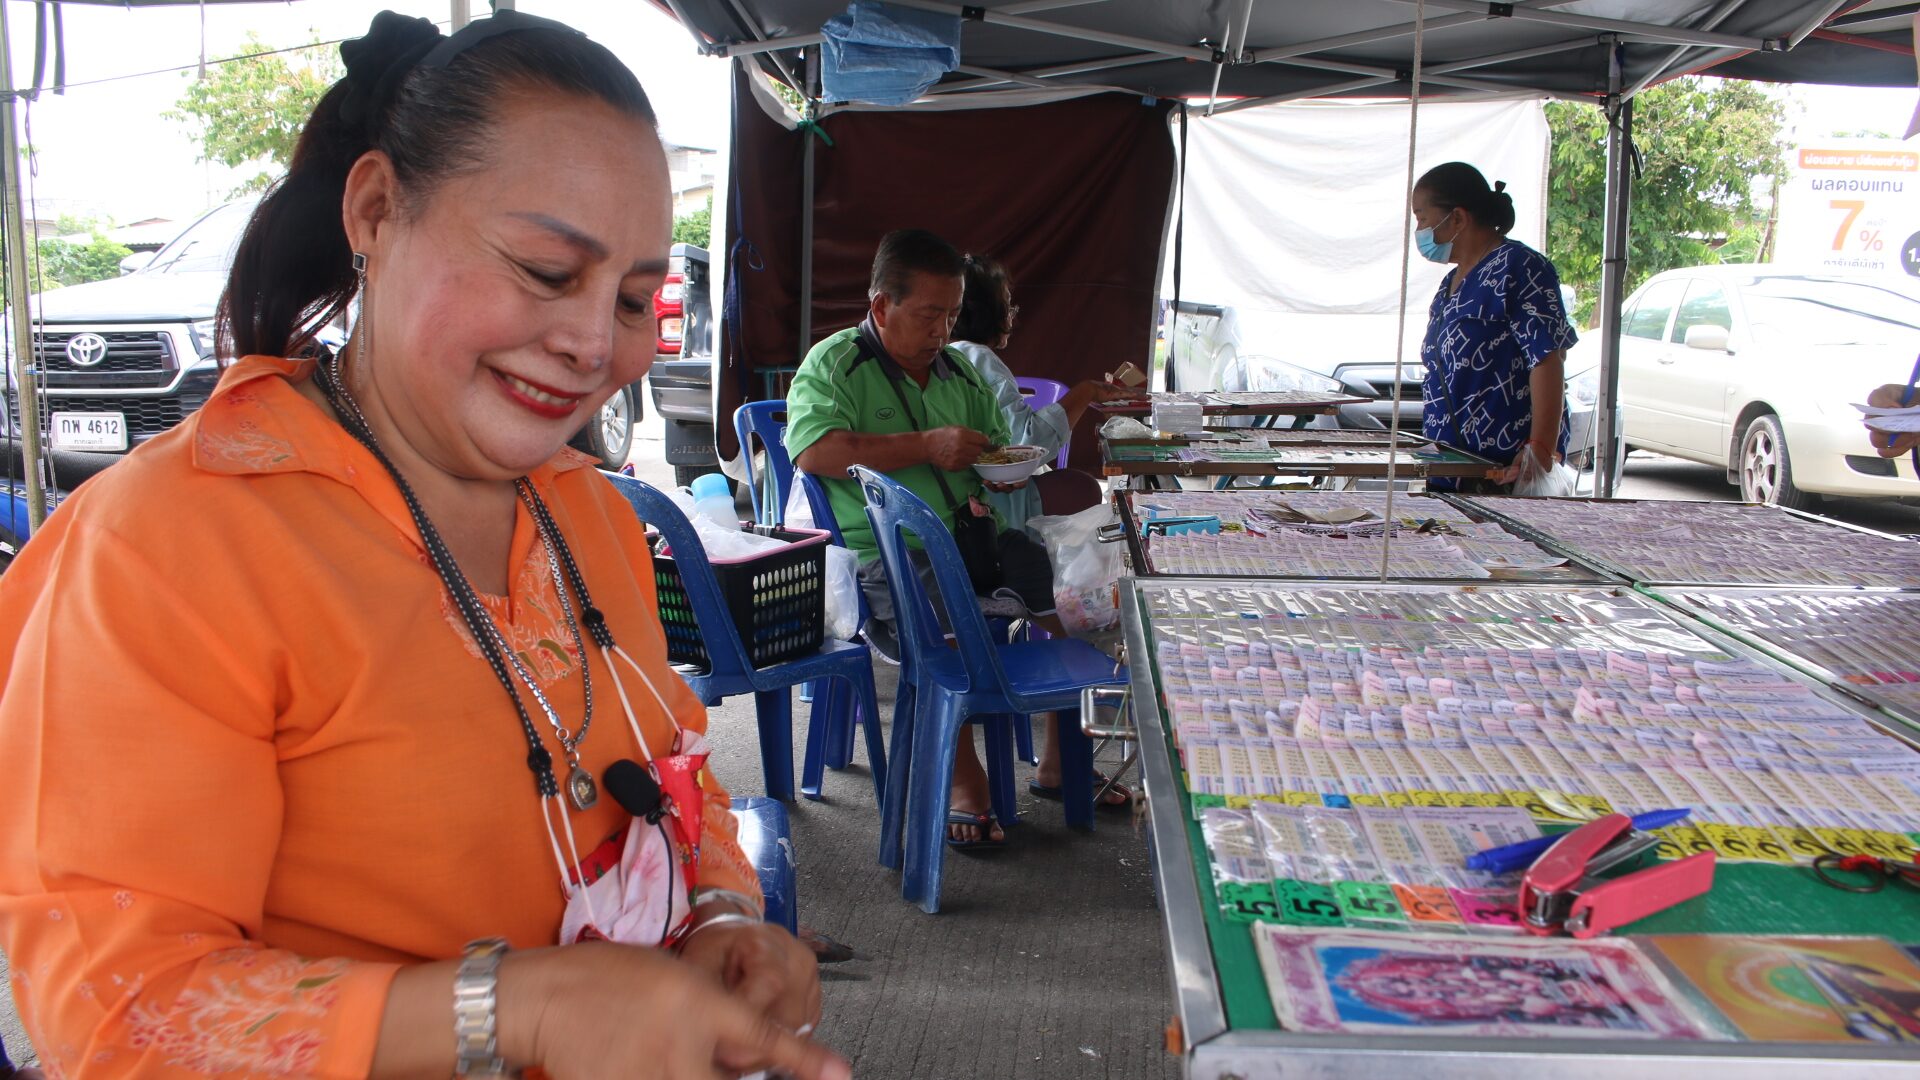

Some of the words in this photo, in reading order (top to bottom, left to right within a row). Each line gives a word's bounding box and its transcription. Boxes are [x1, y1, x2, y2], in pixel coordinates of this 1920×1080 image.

[1812, 179, 1903, 193] ผลตอบแทน
[88, 420, 119, 434] 4612
[1292, 898, 1342, 917] 5
